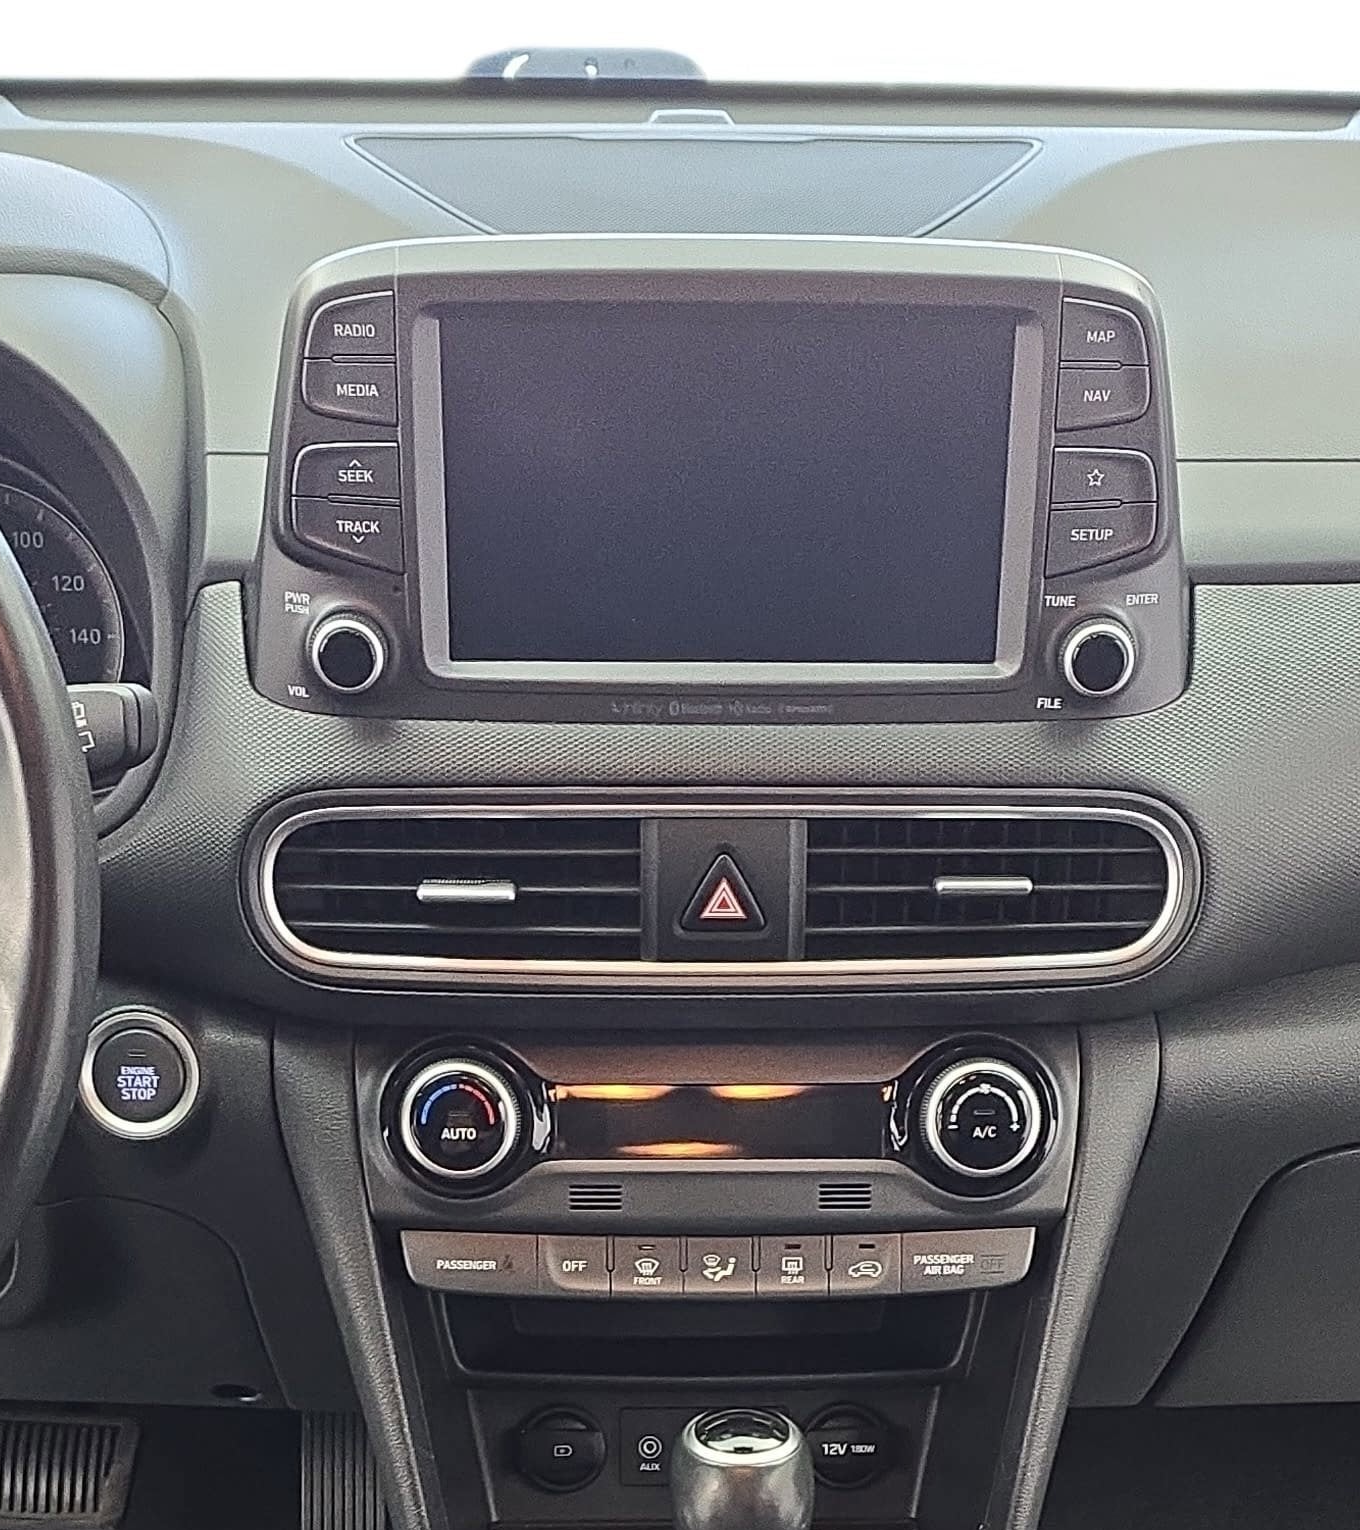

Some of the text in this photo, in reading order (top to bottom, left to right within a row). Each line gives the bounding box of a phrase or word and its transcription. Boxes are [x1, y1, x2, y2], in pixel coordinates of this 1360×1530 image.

[334, 324, 376, 337] RADIO
[1086, 330, 1116, 343] MAP
[336, 384, 379, 397] MEDIA
[1083, 390, 1111, 402] NAV
[338, 470, 373, 483] SEEK
[336, 520, 380, 533] TRACK
[12, 531, 44, 548] 100
[1070, 528, 1114, 542] SETUP
[51, 575, 85, 592] 120
[284, 591, 311, 605] PWR
[1044, 595, 1077, 607] TUNE
[1126, 593, 1159, 606] ENTER
[69, 628, 102, 645] 140
[287, 685, 310, 698] VOL
[1036, 698, 1063, 710] FILE
[120, 1066, 156, 1075] ENGINE
[116, 1076, 160, 1088] START
[121, 1088, 156, 1100] STOP
[441, 1127, 477, 1140] AUTO
[972, 1125, 997, 1139] A/C
[436, 1259, 497, 1271] PASSENGER
[913, 1254, 974, 1266] PASSENGER
[562, 1261, 588, 1272] OFF
[943, 1264, 964, 1275] BAG
[633, 1276, 662, 1285] FRONT
[781, 1275, 804, 1284] REAR
[822, 1443, 847, 1455] 12V
[640, 1463, 661, 1471] AUX
